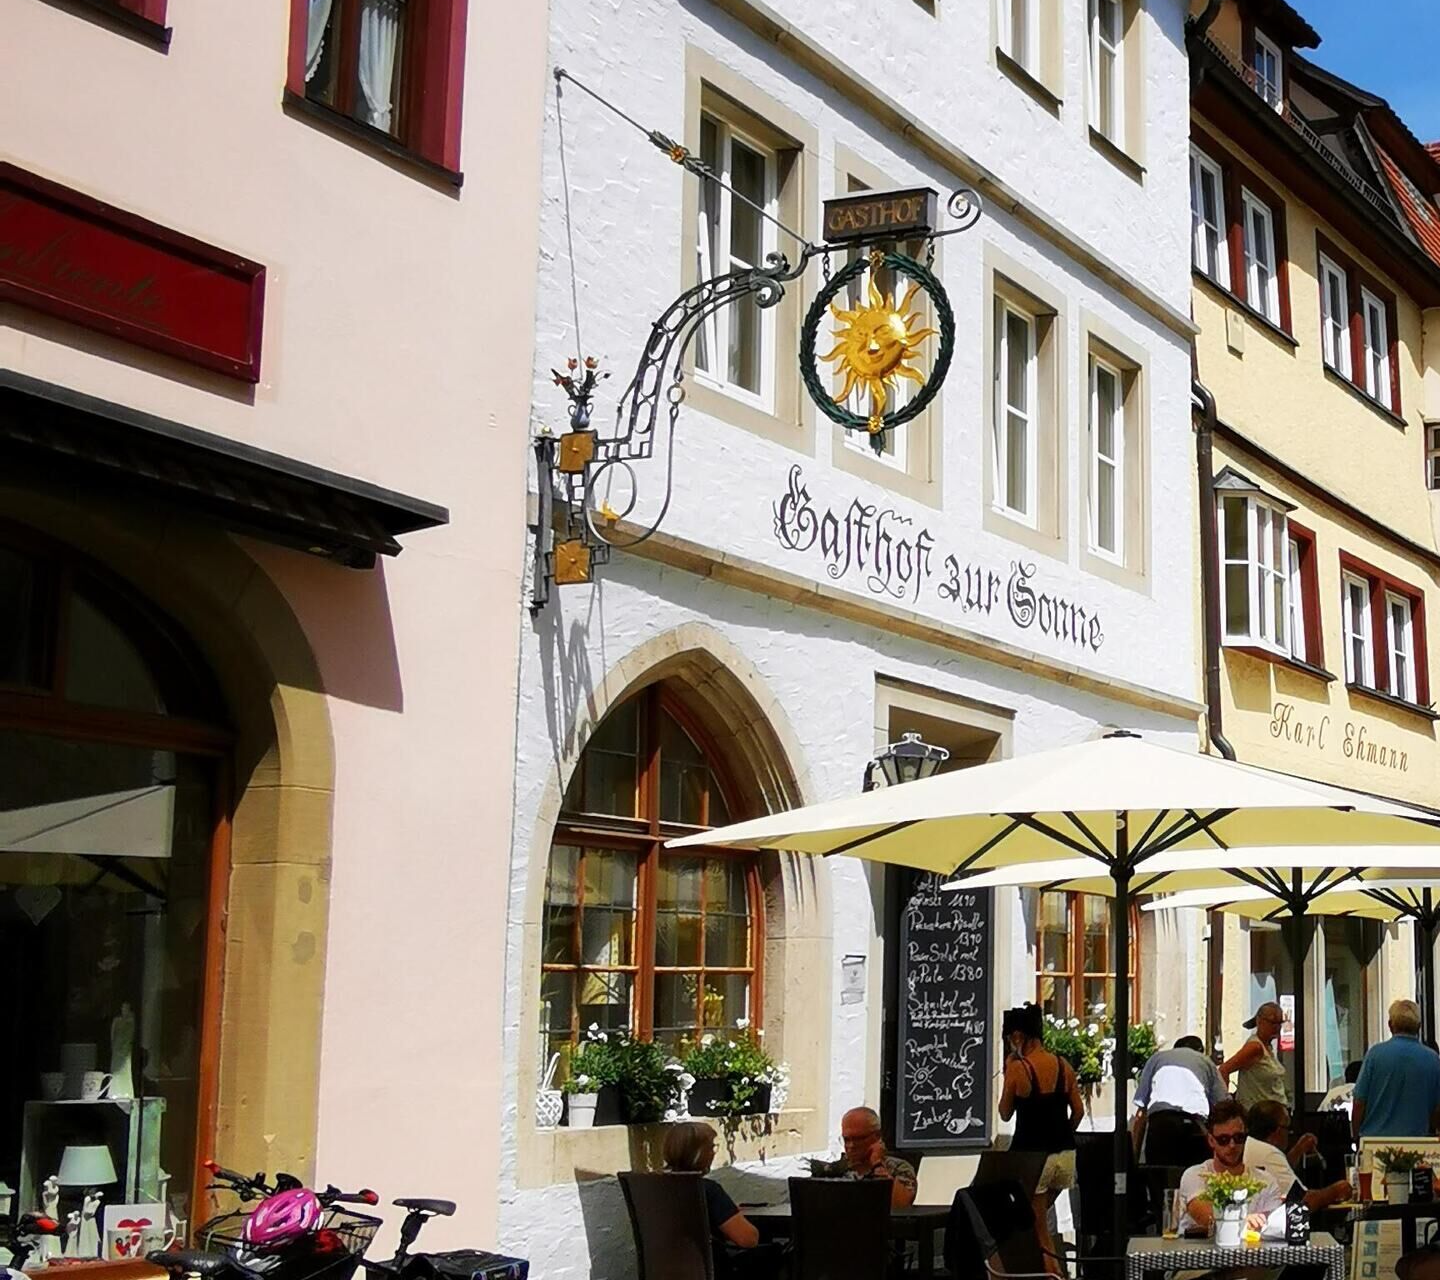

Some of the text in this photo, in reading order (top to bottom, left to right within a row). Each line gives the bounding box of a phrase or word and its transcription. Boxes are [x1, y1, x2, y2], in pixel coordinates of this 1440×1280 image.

[828, 194, 924, 233] GASTHOF
[937, 552, 1001, 616] zur
[1005, 560, 1105, 653] Sonne
[1269, 702, 1409, 773] Karl Ehmann
